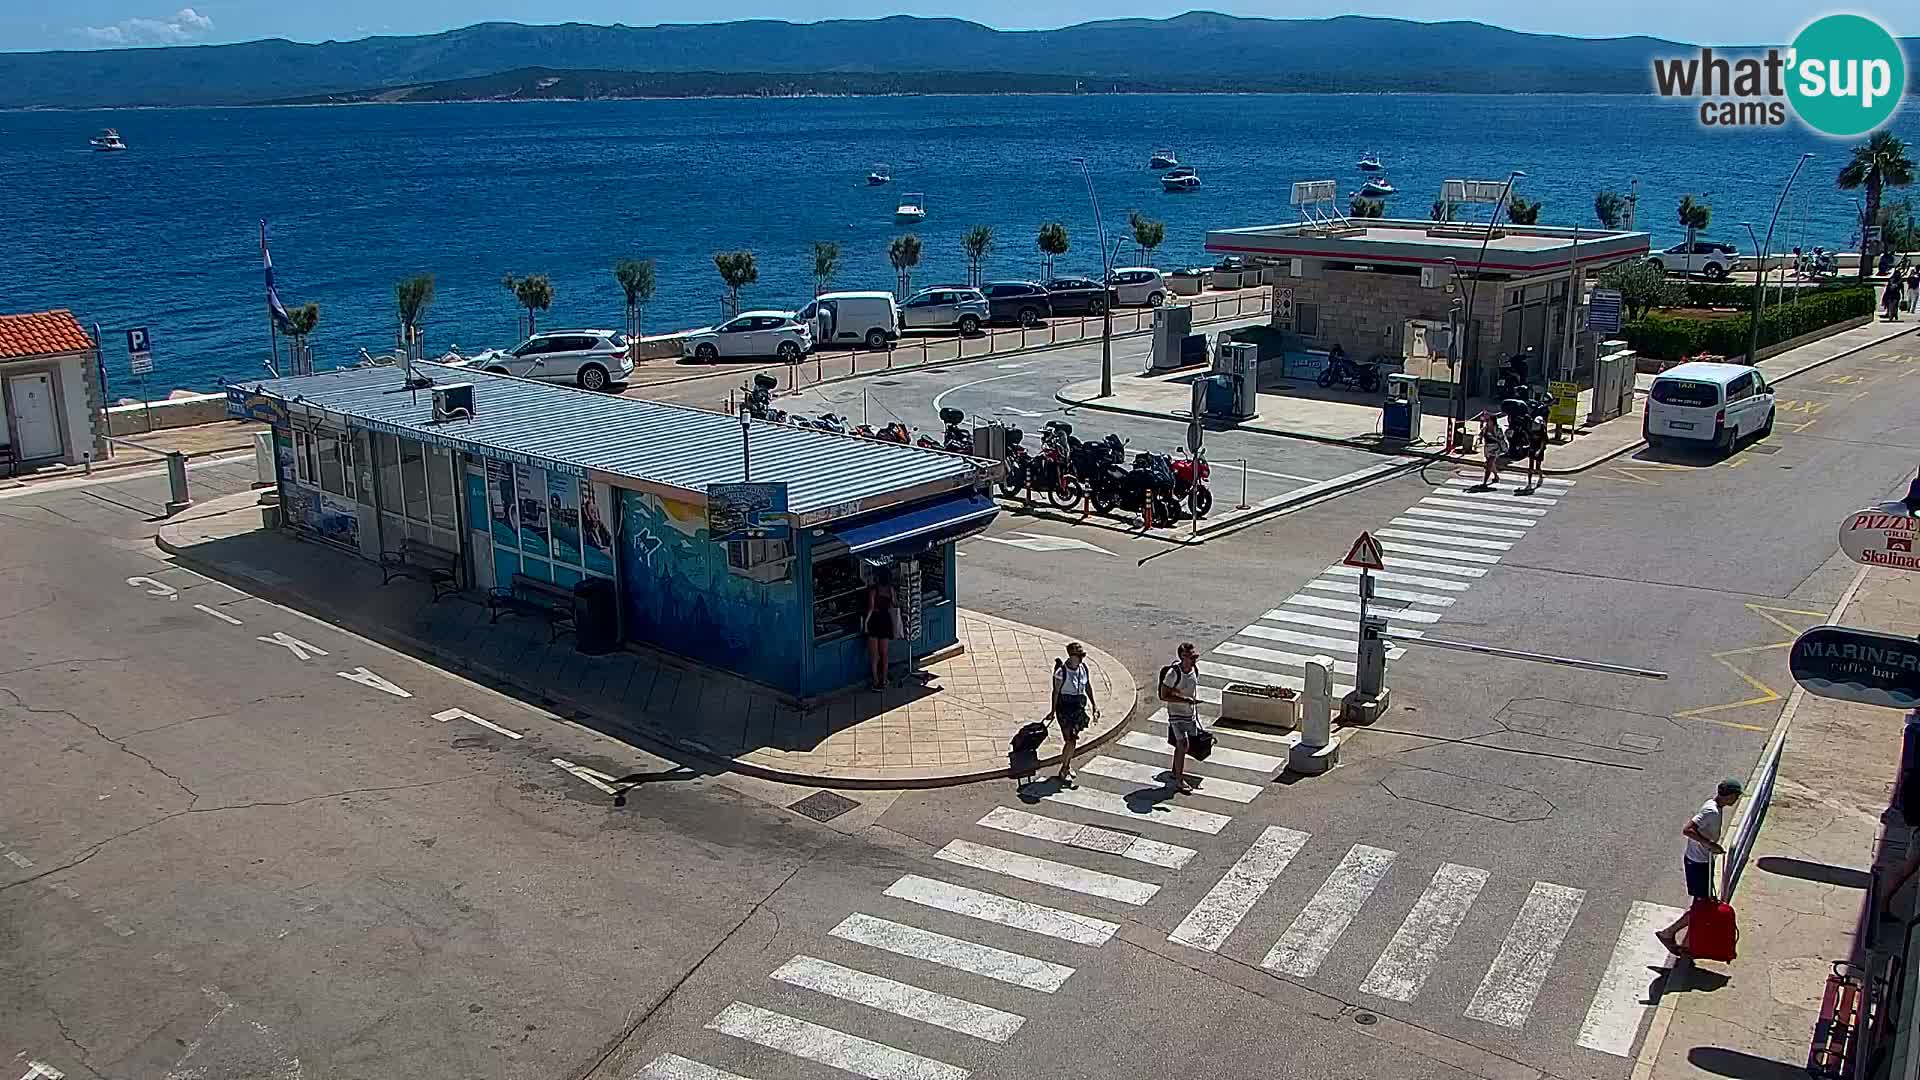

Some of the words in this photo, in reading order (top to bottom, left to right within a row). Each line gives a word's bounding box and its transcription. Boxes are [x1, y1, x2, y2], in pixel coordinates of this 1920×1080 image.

[480, 446, 494, 457] BUS
[495, 448, 528, 465] STATION
[529, 456, 556, 471] TICKET
[556, 463, 585, 477] OFFICE
[1849, 514, 1920, 532] PIZZE
[1872, 665, 1899, 680] bar
